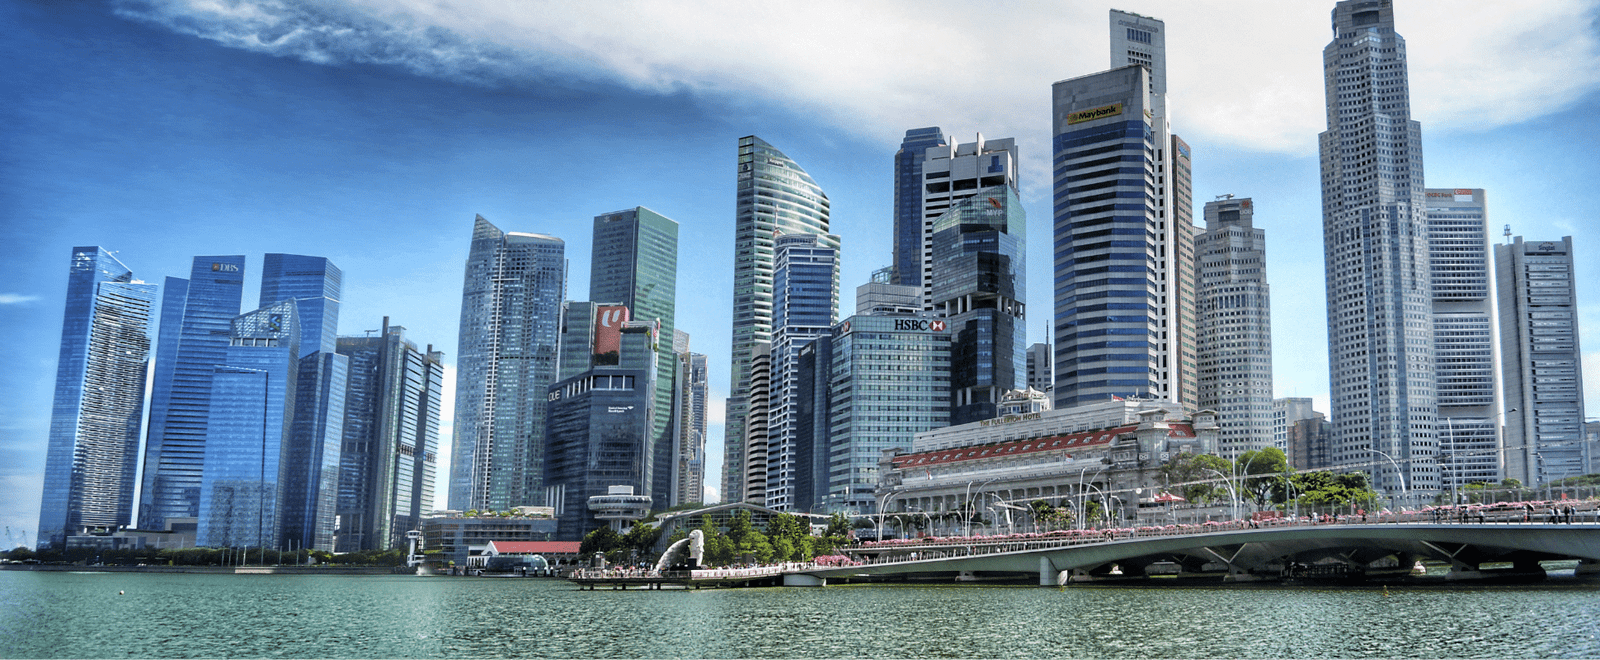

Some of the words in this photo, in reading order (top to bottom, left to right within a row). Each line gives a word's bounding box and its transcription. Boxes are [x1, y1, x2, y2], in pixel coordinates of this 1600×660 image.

[1079, 106, 1116, 119] Maybank
[220, 263, 239, 271] DBS
[894, 319, 928, 331] HSBC
[548, 389, 561, 402] OUE
[1022, 413, 1041, 421] HOTEL
